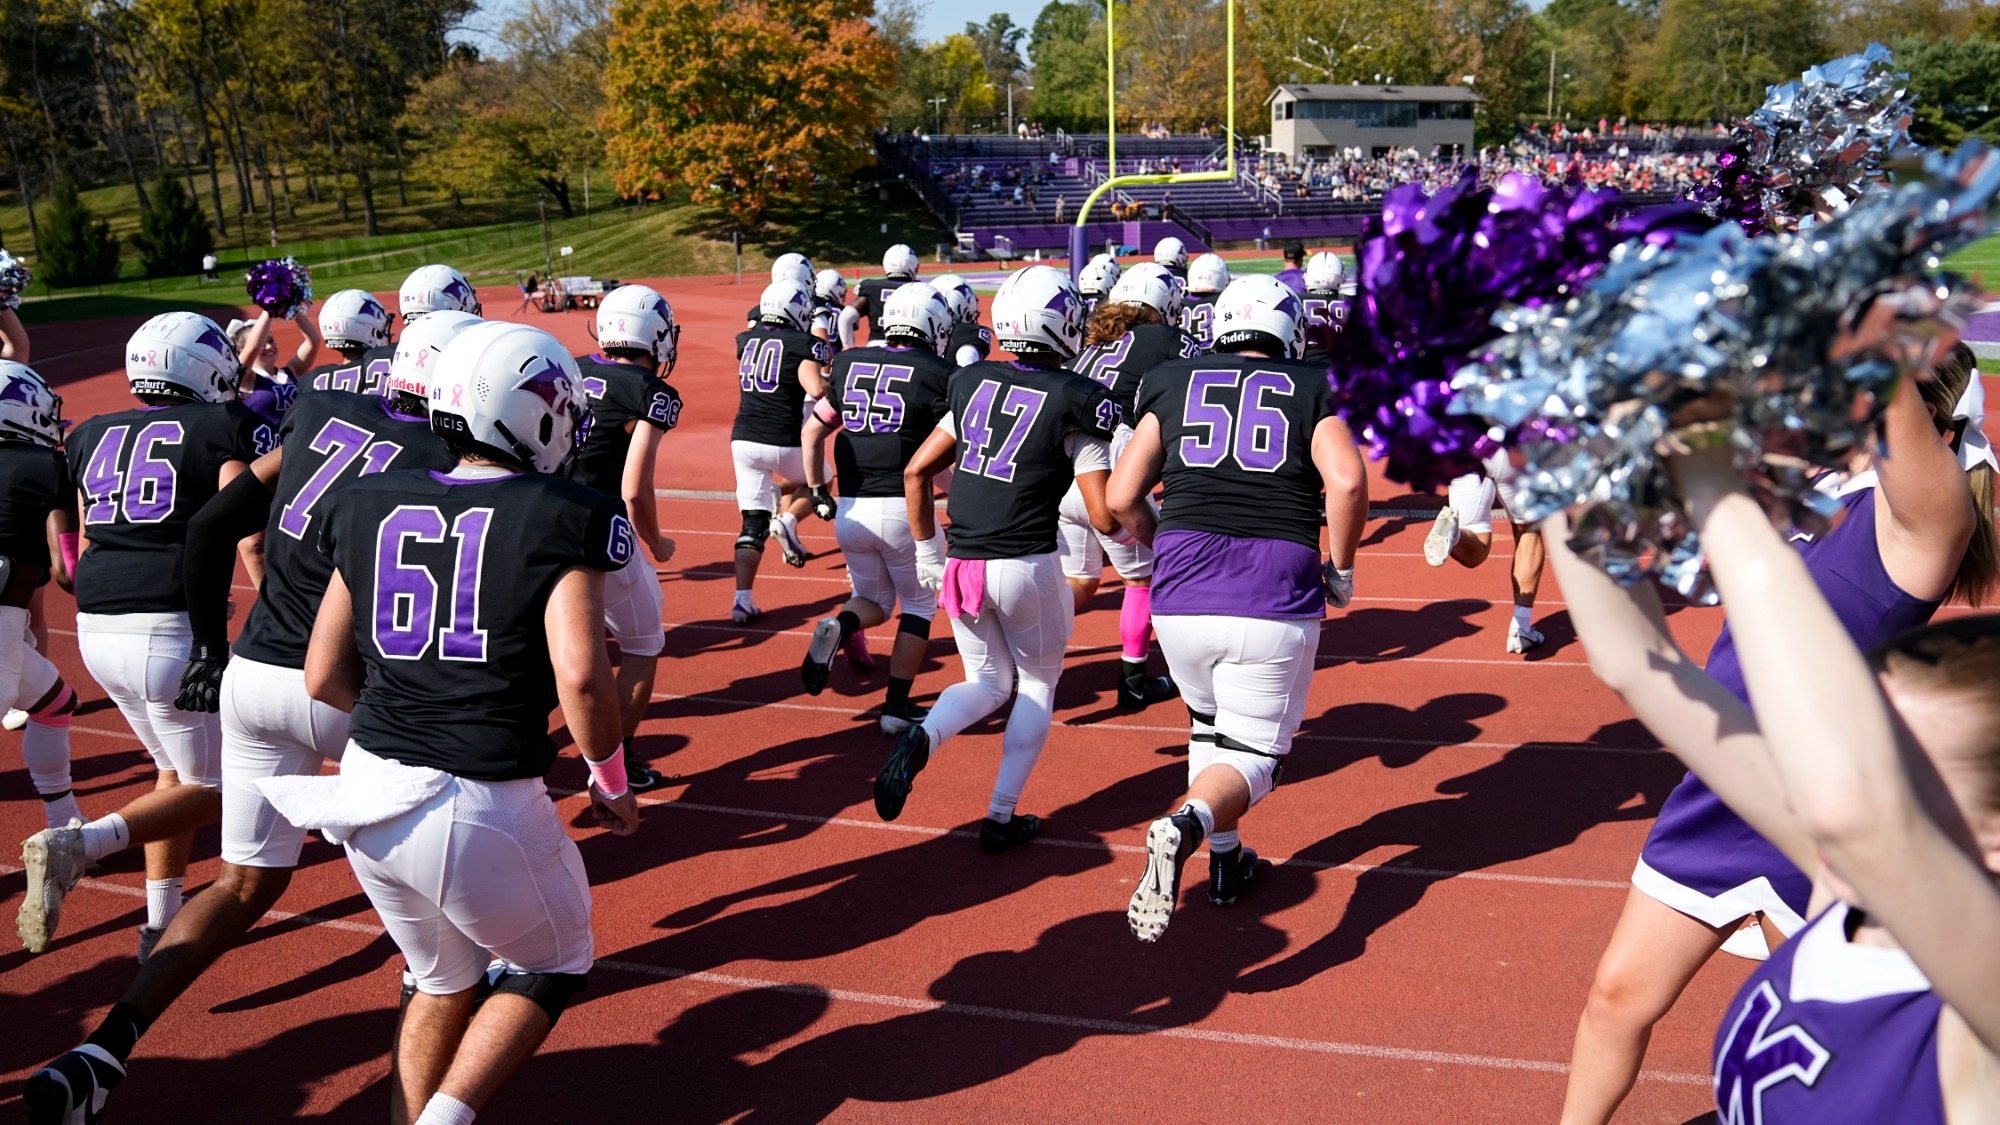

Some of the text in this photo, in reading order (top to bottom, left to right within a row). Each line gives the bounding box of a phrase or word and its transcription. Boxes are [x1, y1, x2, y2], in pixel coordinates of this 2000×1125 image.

[997, 322, 1004, 330] 47
[1224, 312, 1232, 321] 56
[1002, 339, 1027, 348] schutt
[1220, 331, 1258, 344] Ridde
[131, 353, 139, 362] 46
[740, 338, 784, 393] 40
[135, 379, 166, 390] schutt
[433, 387, 441, 400] 61
[272, 385, 298, 411] K
[842, 362, 914, 433] 55
[432, 415, 464, 431] VICIS
[959, 379, 1048, 483] 47
[1179, 369, 1296, 473] 56
[82, 421, 185, 525] 46
[372, 504, 495, 662] 61
[1713, 979, 1831, 1125] K
